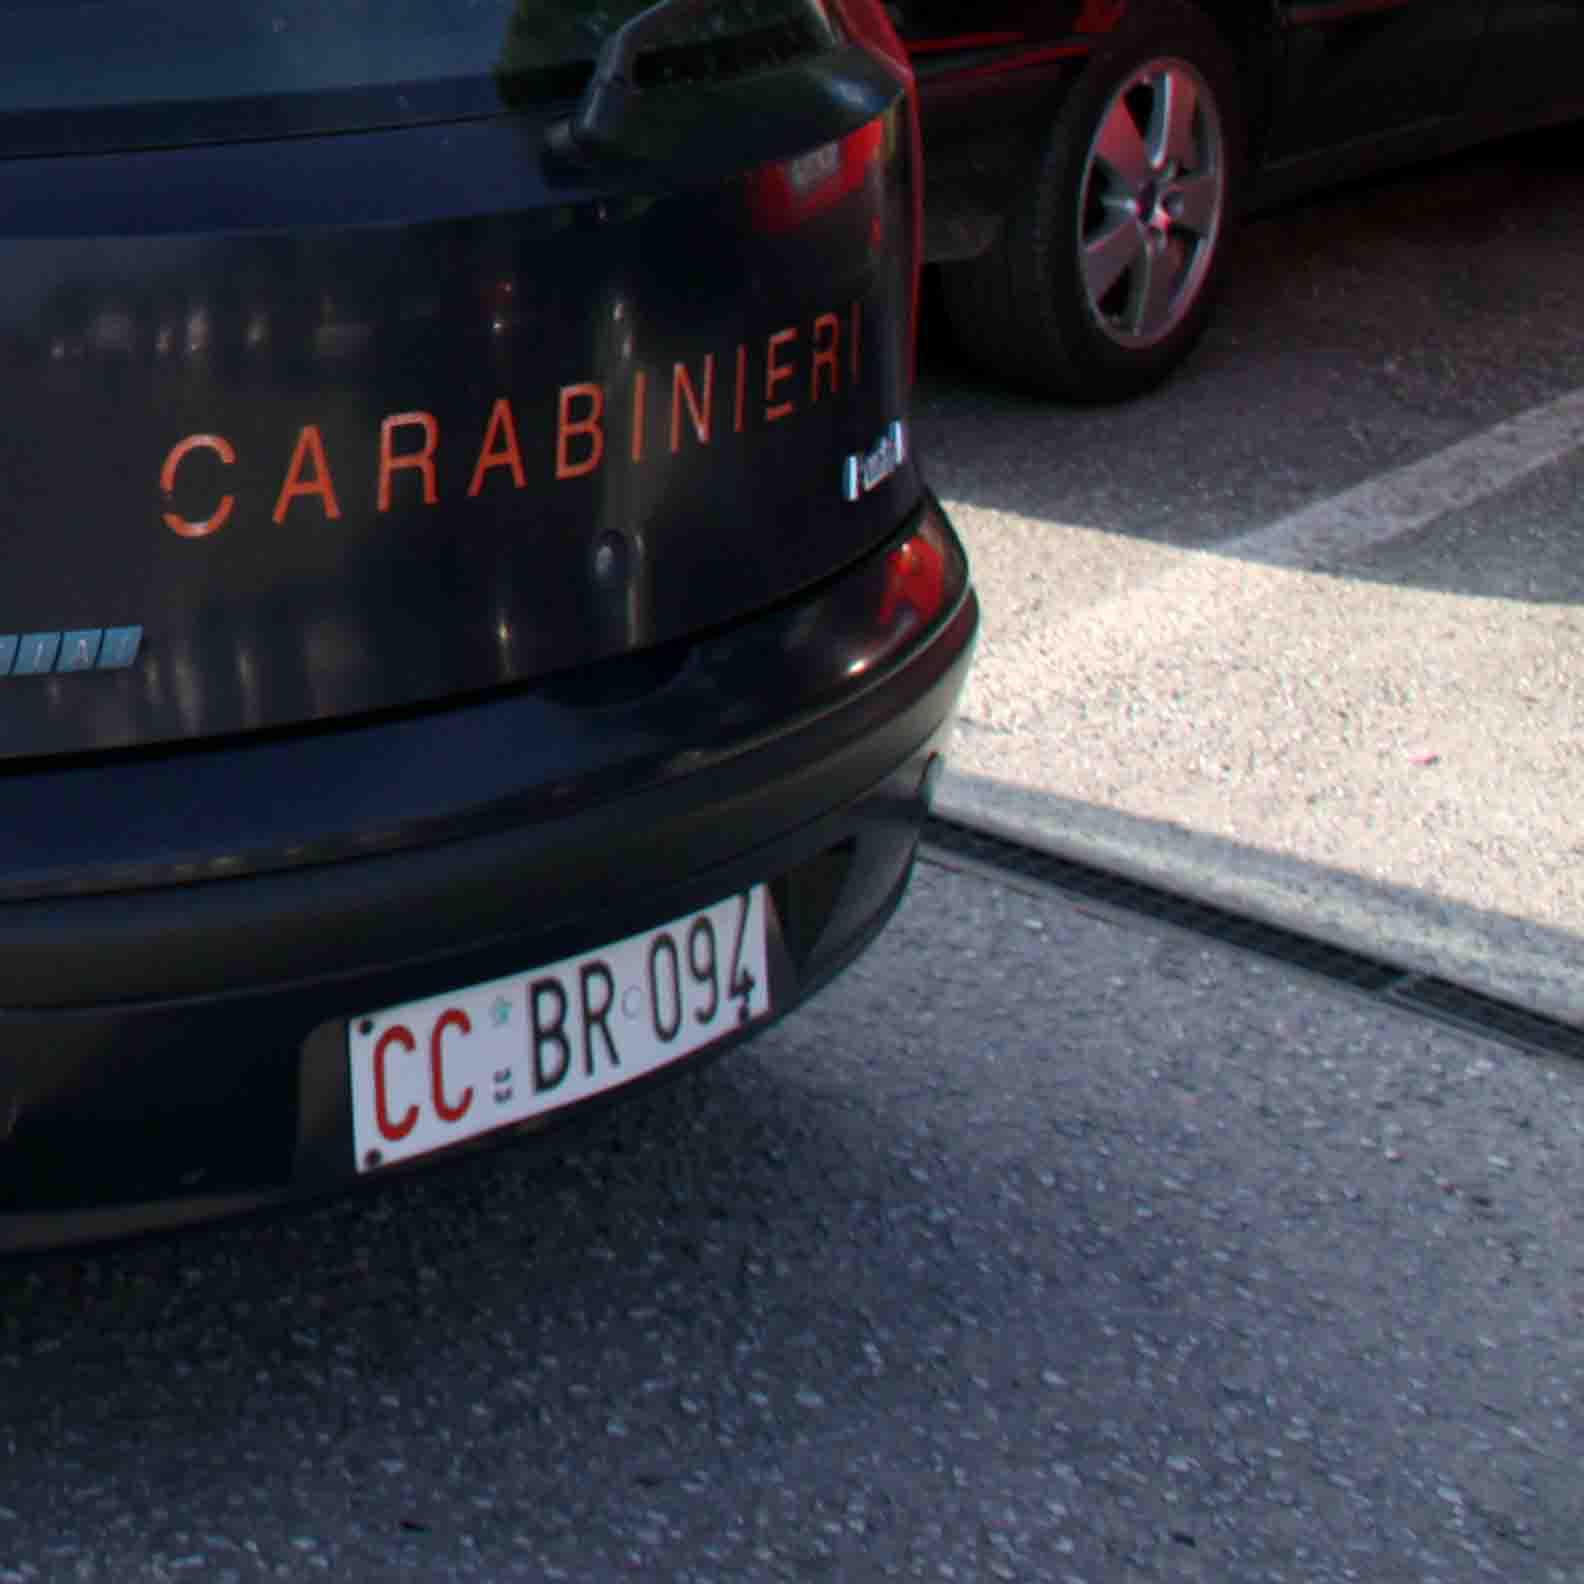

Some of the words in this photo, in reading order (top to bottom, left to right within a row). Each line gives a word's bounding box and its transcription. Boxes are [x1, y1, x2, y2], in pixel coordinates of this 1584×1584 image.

[159, 300, 862, 538] CARABINIERI
[372, 1008, 474, 1142] CC
[528, 959, 621, 1094] BR
[649, 886, 755, 1043] 094
